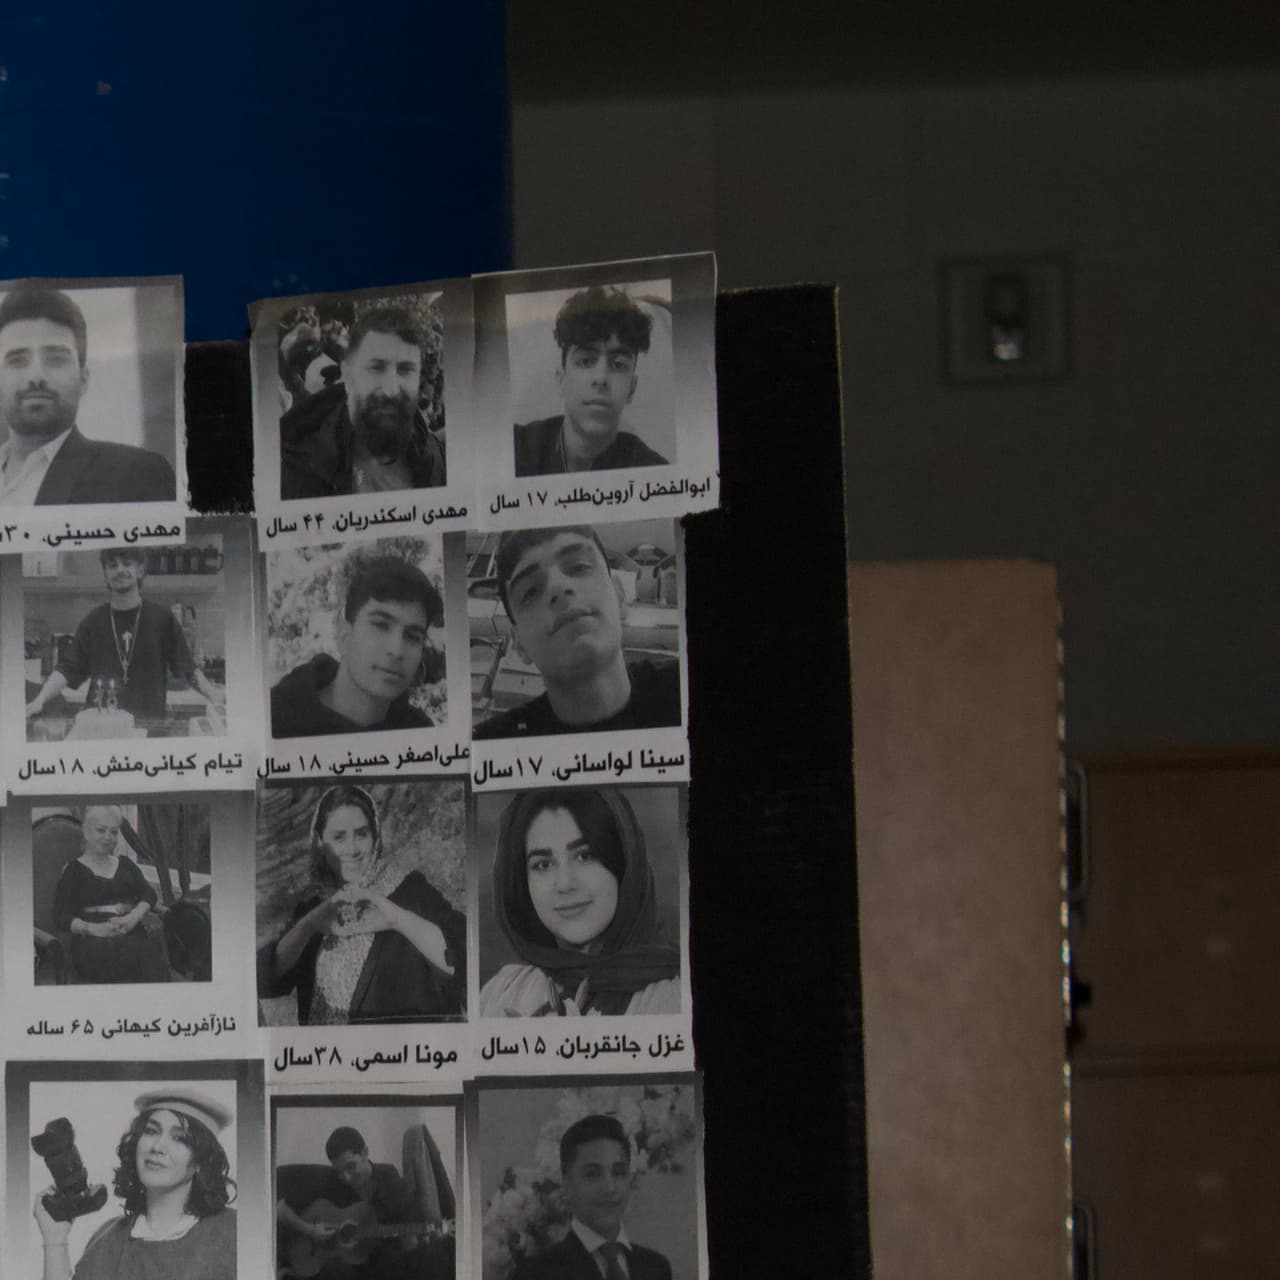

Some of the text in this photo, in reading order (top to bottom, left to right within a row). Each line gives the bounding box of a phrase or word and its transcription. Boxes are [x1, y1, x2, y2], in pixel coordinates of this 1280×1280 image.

[528, 491, 547, 506] ۱۷
[639, 477, 710, 502] ابوالفضل
[490, 494, 520, 514] سال
[303, 513, 324, 531] ۴۴
[422, 506, 467, 525] مهدی
[266, 517, 297, 538] سال
[258, 757, 291, 774] سال
[299, 754, 321, 771] ۱۸
[27, 1014, 236, 1039] نازآفرین کیهانی ۶۵ ساله
